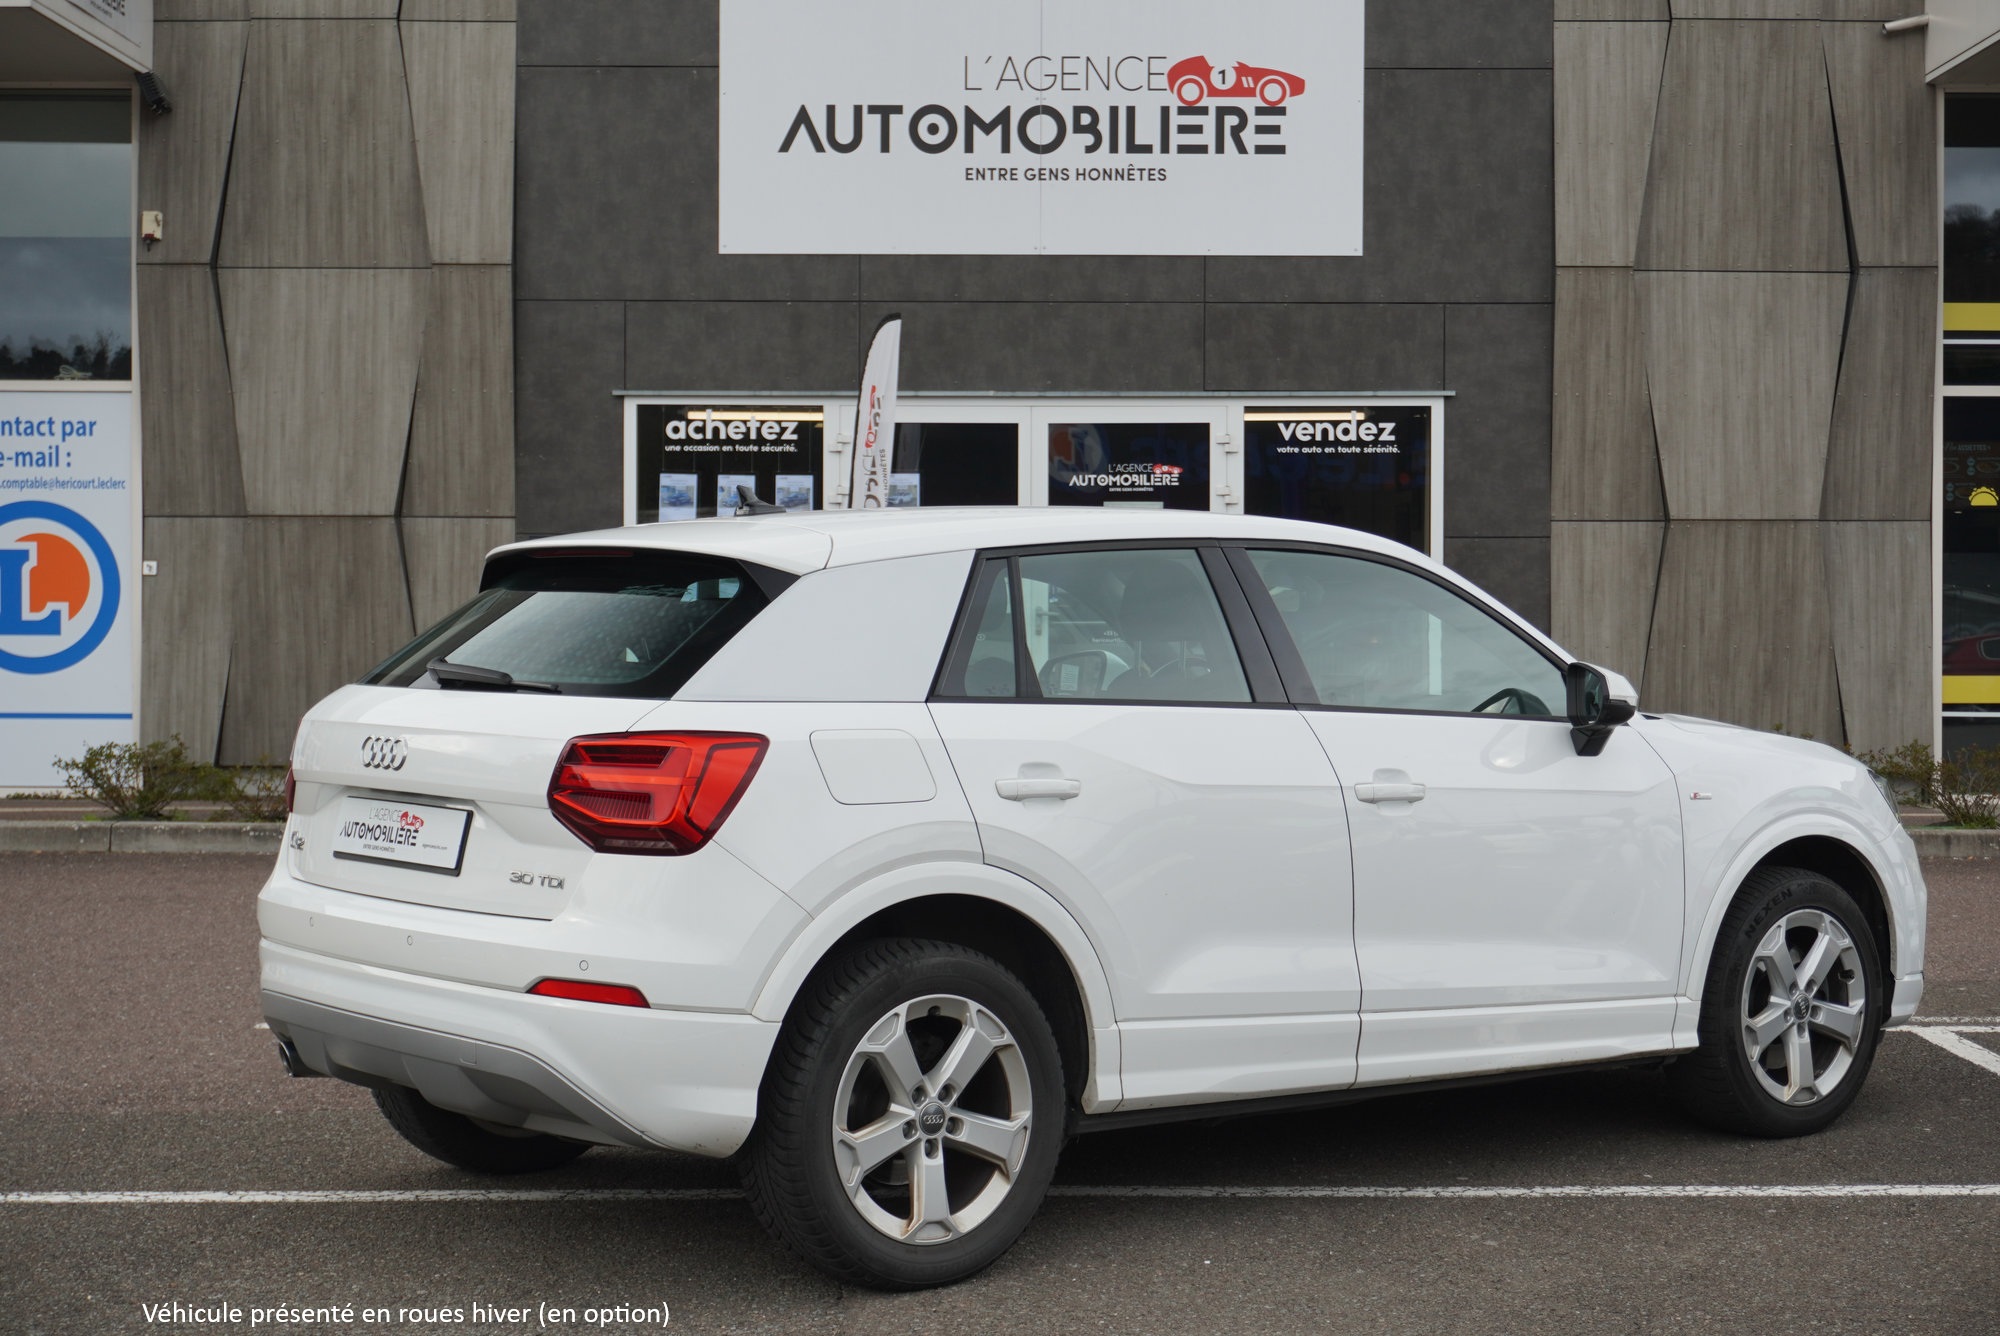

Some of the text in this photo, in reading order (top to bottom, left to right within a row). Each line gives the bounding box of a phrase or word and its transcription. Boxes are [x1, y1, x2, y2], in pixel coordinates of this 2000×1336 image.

[1218, 69, 1226, 85] 1
[965, 164, 1167, 181] ENTRE GENS HONNÊTES
[61, 420, 97, 442] par
[665, 408, 799, 440] achetez
[1277, 410, 1396, 441] vendez
[664, 444, 681, 452] une
[683, 443, 720, 452] occasion
[722, 444, 733, 452] en
[735, 444, 759, 452] toute
[1276, 446, 1300, 454] votre
[1301, 446, 1322, 454] auto
[1337, 446, 1361, 454] toute
[1108, 463, 1153, 473] L'AGENCE
[509, 870, 565, 890] 30 TDI
[1744, 888, 1794, 938] NEXEN
